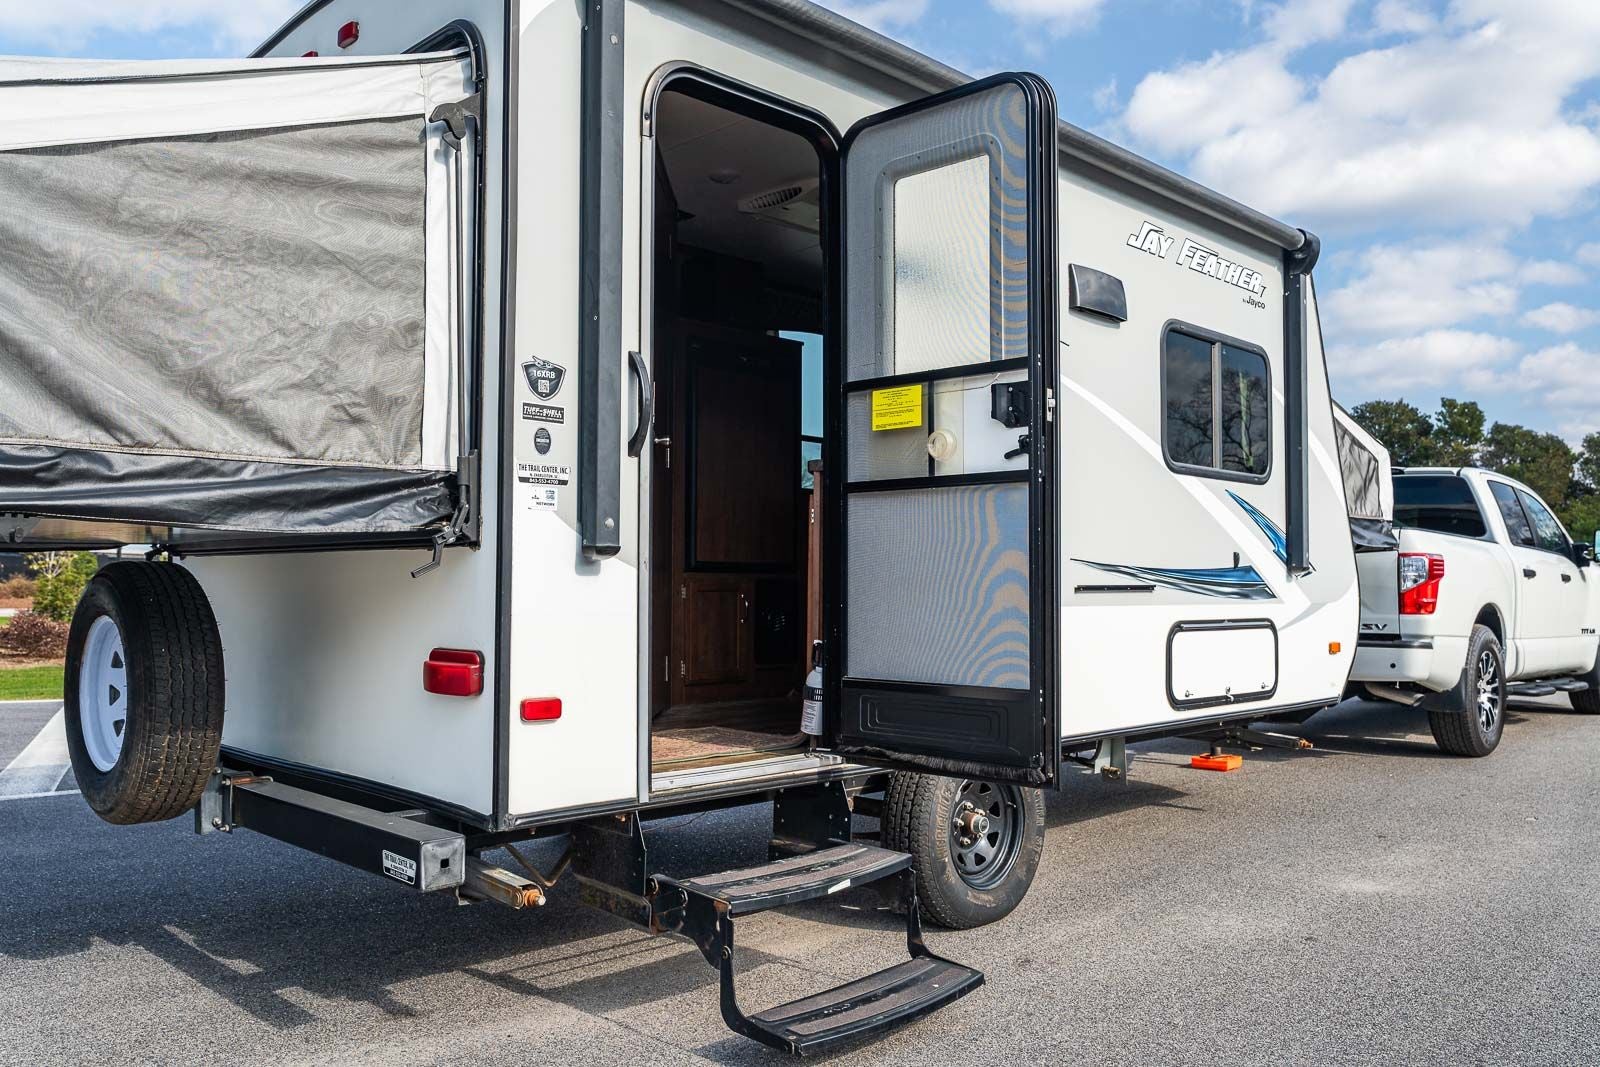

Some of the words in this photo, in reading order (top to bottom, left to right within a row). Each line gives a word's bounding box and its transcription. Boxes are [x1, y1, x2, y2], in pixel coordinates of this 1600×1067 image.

[1126, 221, 1174, 259] JAY
[1176, 238, 1267, 297] FEATHER
[1246, 295, 1266, 309] Jayco
[533, 370, 556, 379] 16XRB
[527, 464, 541, 473] TRAIL
